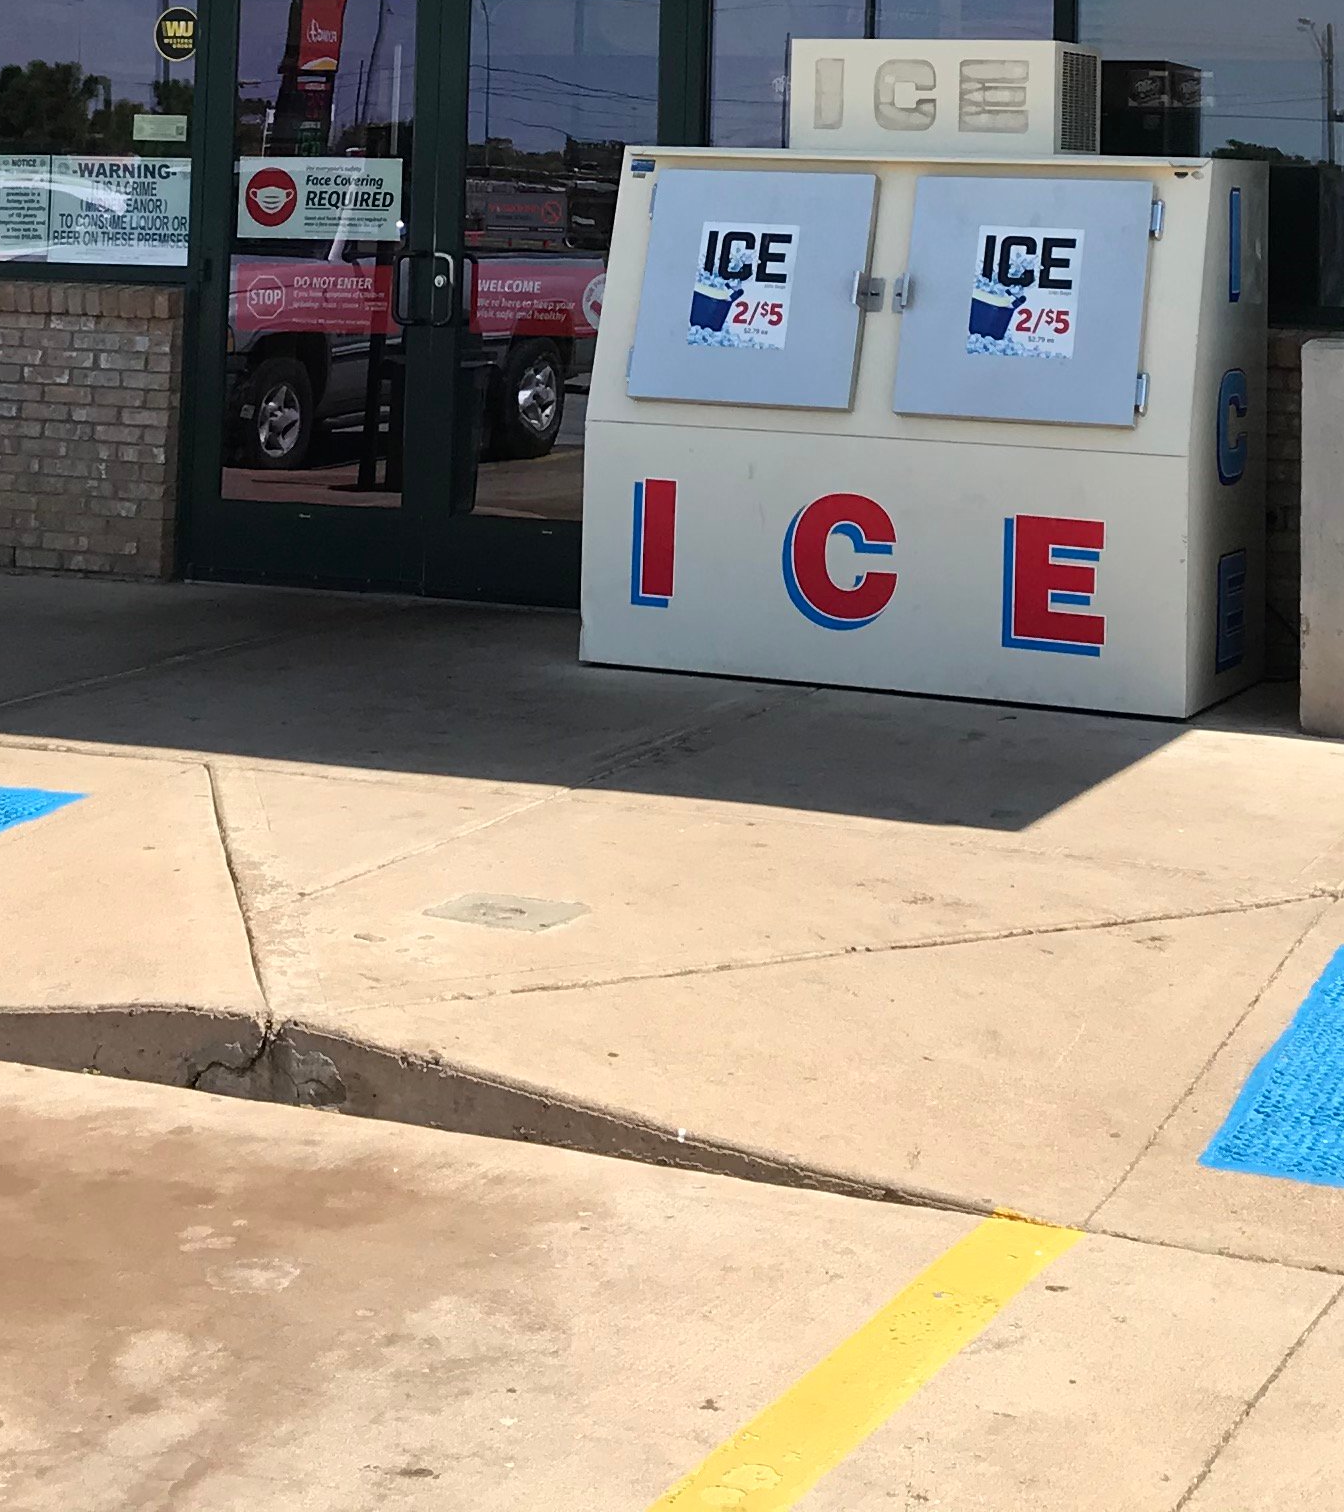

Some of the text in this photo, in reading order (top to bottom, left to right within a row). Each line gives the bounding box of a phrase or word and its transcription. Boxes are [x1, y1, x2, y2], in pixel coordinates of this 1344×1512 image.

[161, 20, 194, 37] WU
[813, 58, 1032, 134] ICE
[11, 158, 37, 168] NOTICE
[123, 181, 158, 197] CRIME
[305, 174, 384, 190] Face Covering
[305, 190, 394, 209] REQUIRED
[58, 213, 188, 231] TO CONSUME LIQUOR OR
[53, 230, 189, 249] BEER ON THESE PREMISES
[703, 230, 793, 284] ICE
[981, 234, 1077, 290] ICE
[294, 276, 373, 290] DO NOT ENTER
[477, 279, 542, 294] WELCOME
[250, 289, 282, 305] STOP
[501, 298, 521, 309] here
[556, 301, 576, 311] your
[496, 309, 514, 320] safe
[516, 309, 534, 321] and
[534, 310, 567, 324] healthy
[732, 300, 784, 326] 2/$5
[1015, 308, 1071, 335] 2/$5
[1028, 335, 1046, 343] $2.79
[1215, 185, 1248, 676] ICE
[631, 478, 1106, 658] ICE
